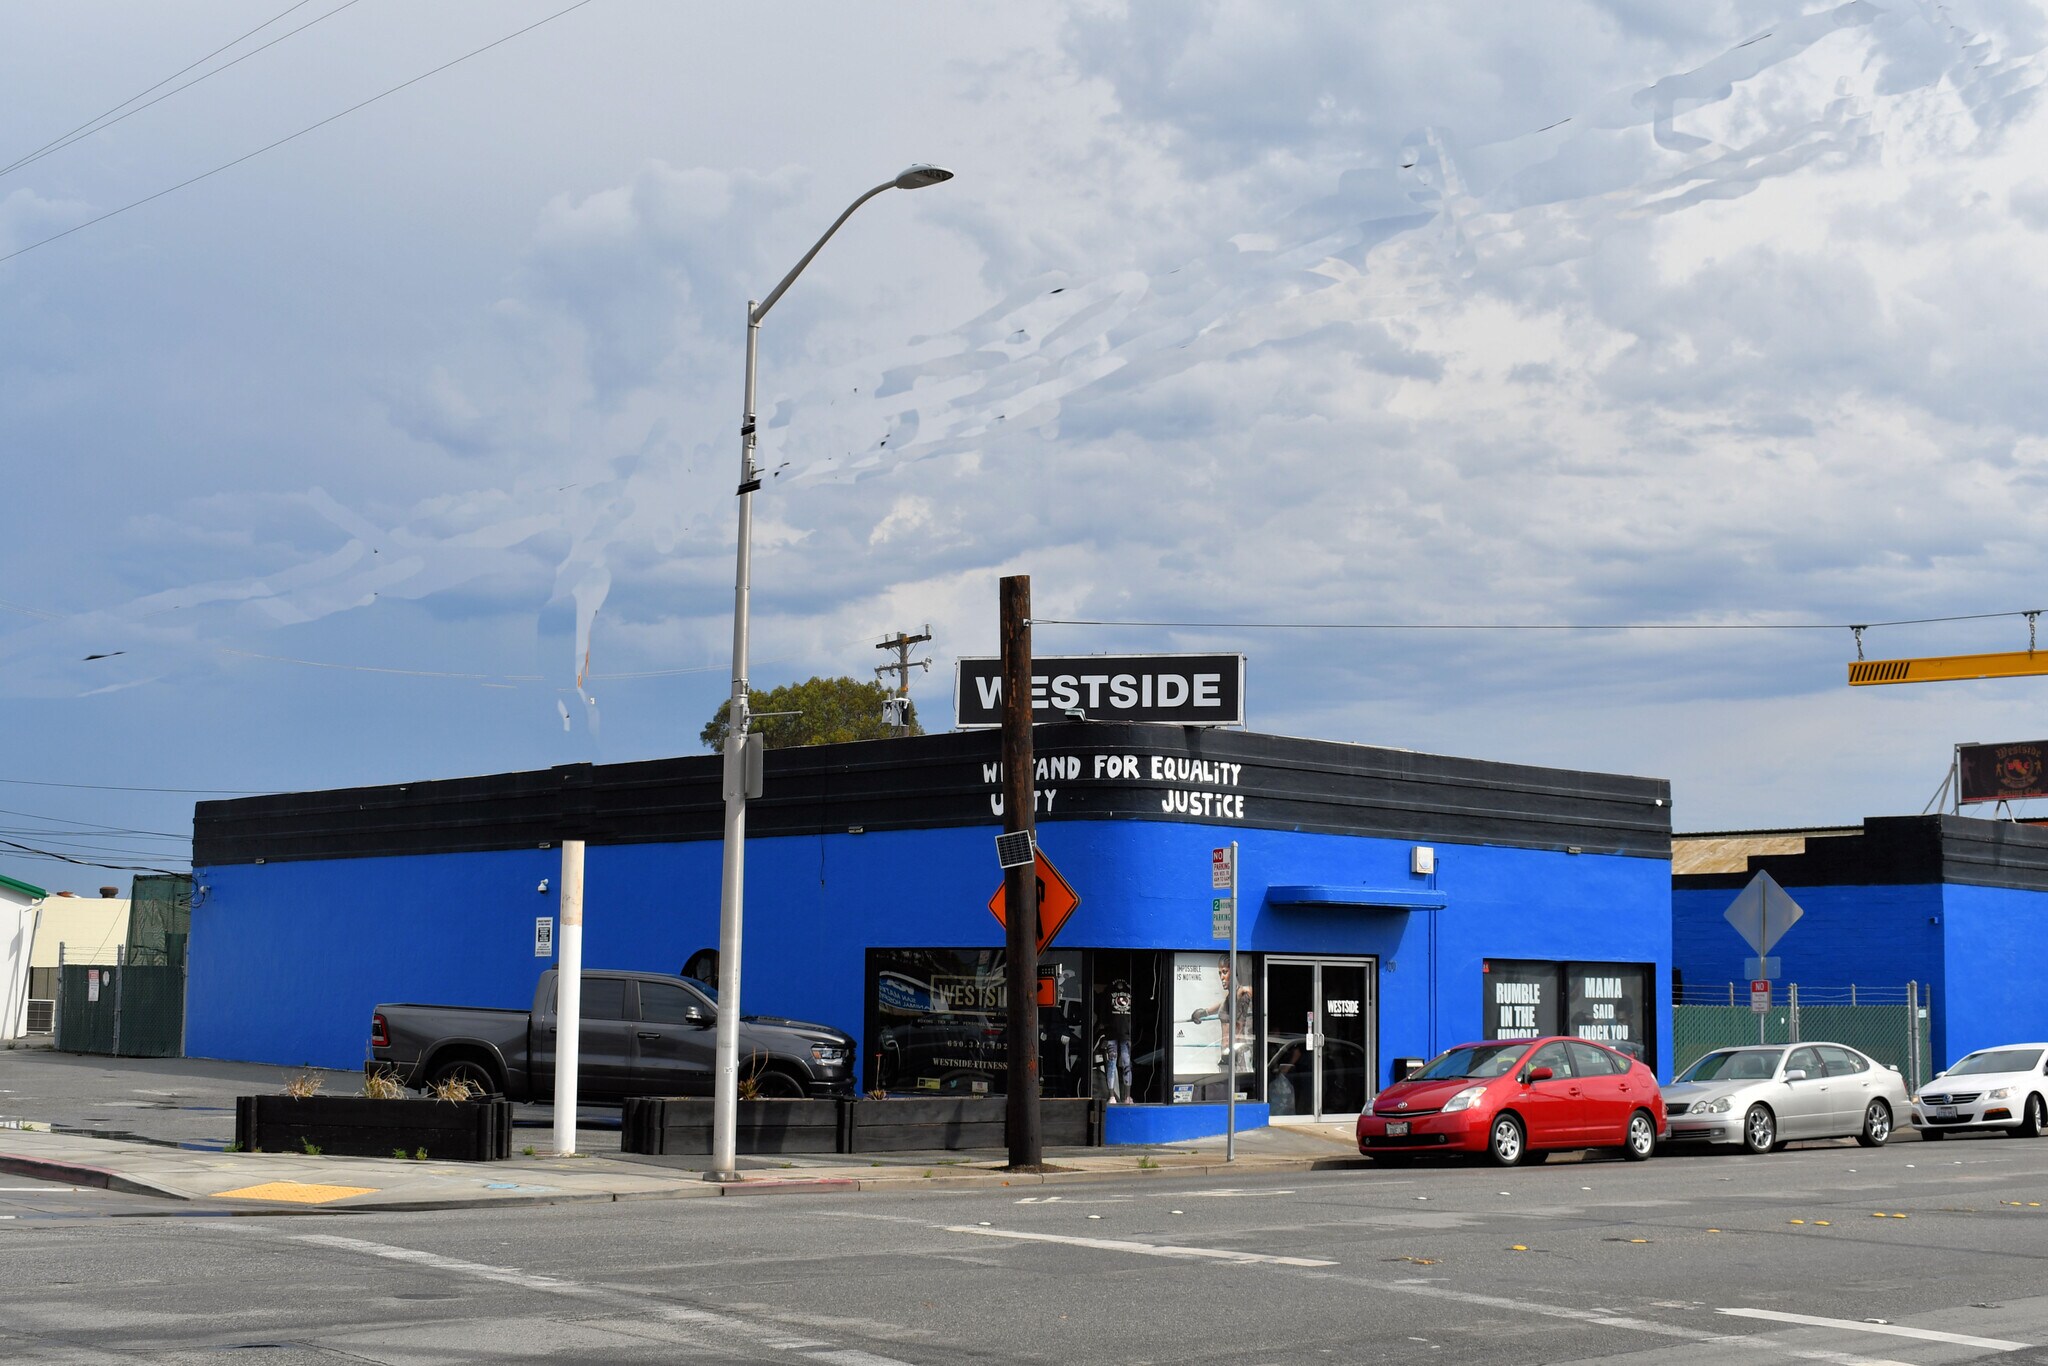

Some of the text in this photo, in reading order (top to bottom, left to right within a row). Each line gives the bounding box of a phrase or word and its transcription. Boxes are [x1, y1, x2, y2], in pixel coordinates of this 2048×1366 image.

[975, 673, 1221, 710] WESTSIDE
[983, 762, 1004, 783] W
[1033, 756, 1081, 780] AND
[1094, 755, 1140, 779] FOR
[990, 789, 1057, 816] UTY
[1213, 851, 1223, 860] NO
[1214, 900, 1219, 910] 2
[1177, 964, 1202, 972] IMPOSSIBLE
[1177, 973, 1182, 981] IS
[1496, 983, 1541, 1005] RUMBLE
[1585, 977, 1623, 999] MAMA
[1755, 982, 1765, 991] NO
[939, 984, 1008, 1008] WESTSI
[1327, 1000, 1360, 1014] WESTSIDE
[1593, 1004, 1614, 1019] SAID
[1500, 1006, 1535, 1027] IN THE
[1578, 1025, 1629, 1041] KNOCK YOU
